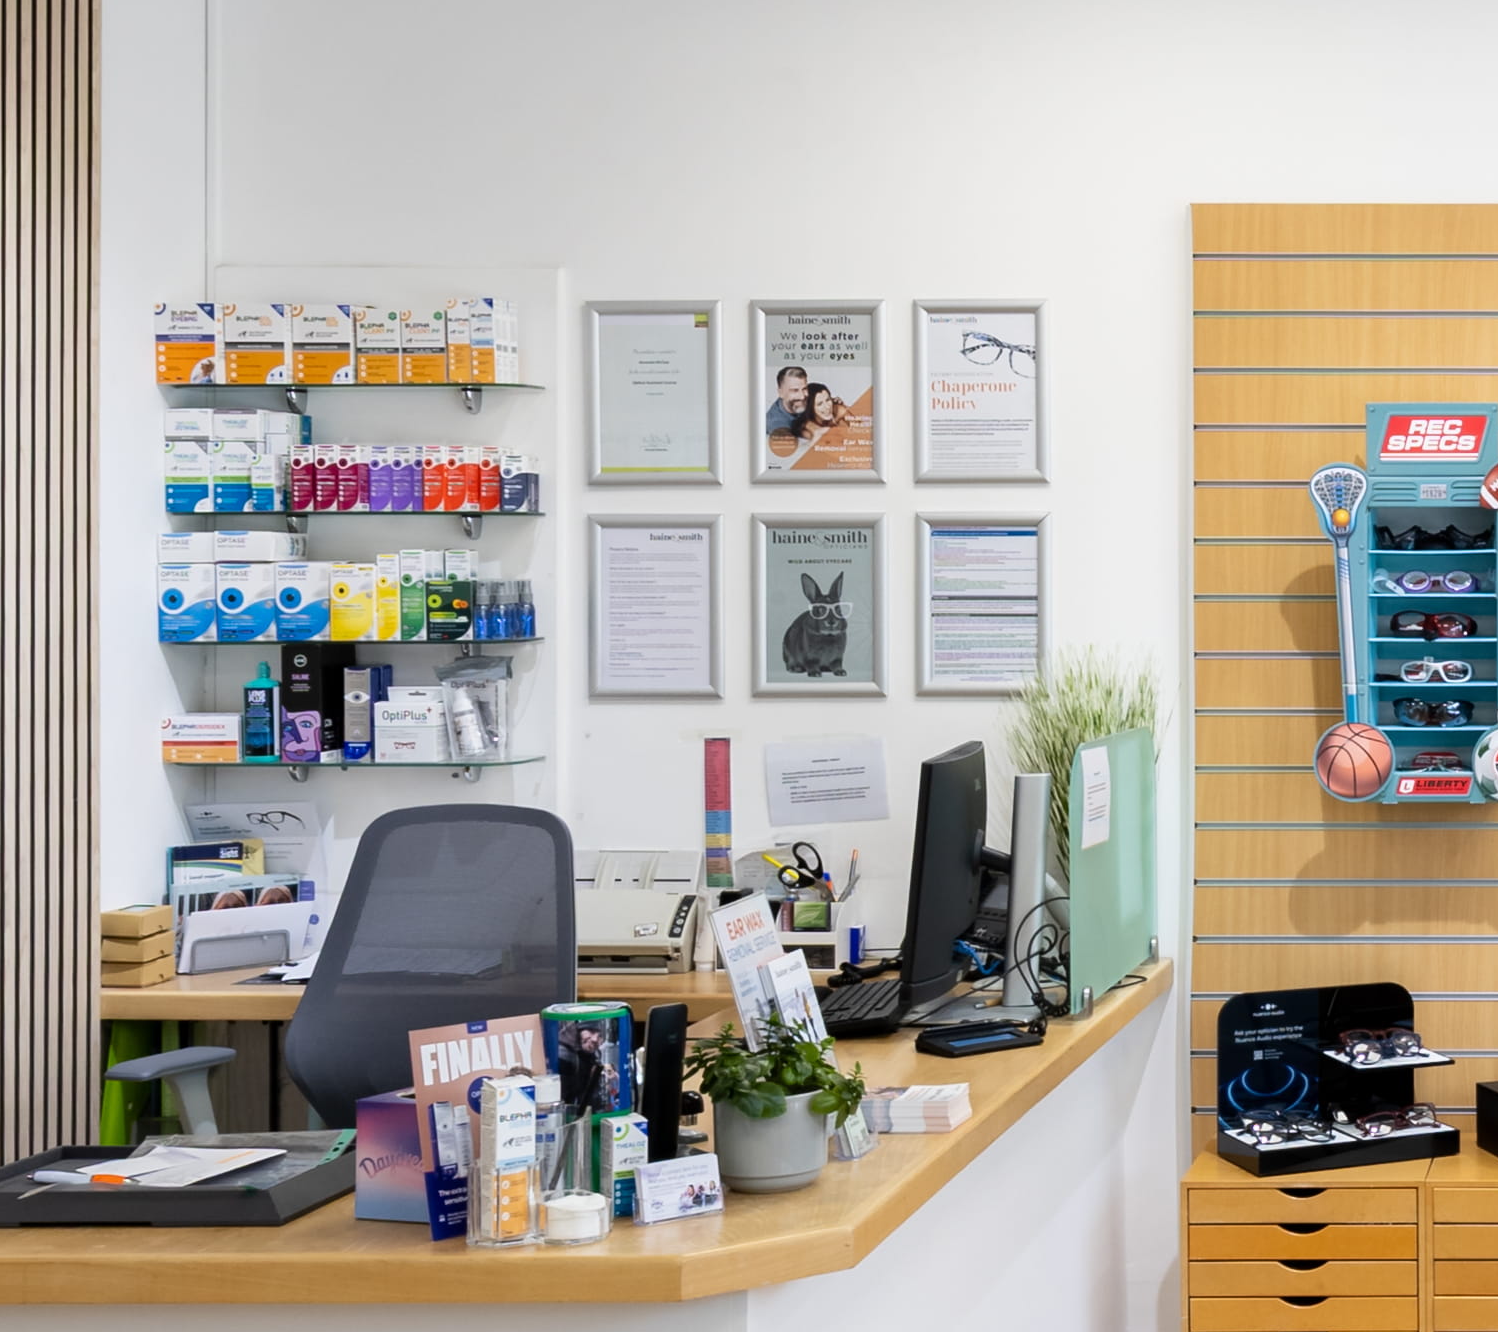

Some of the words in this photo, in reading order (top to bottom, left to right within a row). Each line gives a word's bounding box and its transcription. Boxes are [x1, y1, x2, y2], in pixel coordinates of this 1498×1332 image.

[780, 332, 797, 340] We
[802, 332, 827, 340] look
[831, 332, 859, 341] after
[771, 343, 797, 351] your
[800, 342, 825, 350] ears
[845, 341, 868, 350] well
[800, 353, 825, 361] your
[830, 352, 855, 361] eyes
[931, 380, 1017, 396] Chaperone
[931, 397, 977, 410] Policy
[1408, 419, 1462, 435] REC
[1387, 435, 1476, 451] SPECS
[217, 537, 246, 545] OPTASE
[381, 709, 428, 724] OptiPlus
[1416, 780, 1468, 788] LIBERTY
[726, 917, 747, 941] EAR
[744, 910, 765, 932] WAX
[420, 1030, 534, 1086] FINALLY
[500, 1111, 532, 1122] BLEPHA
